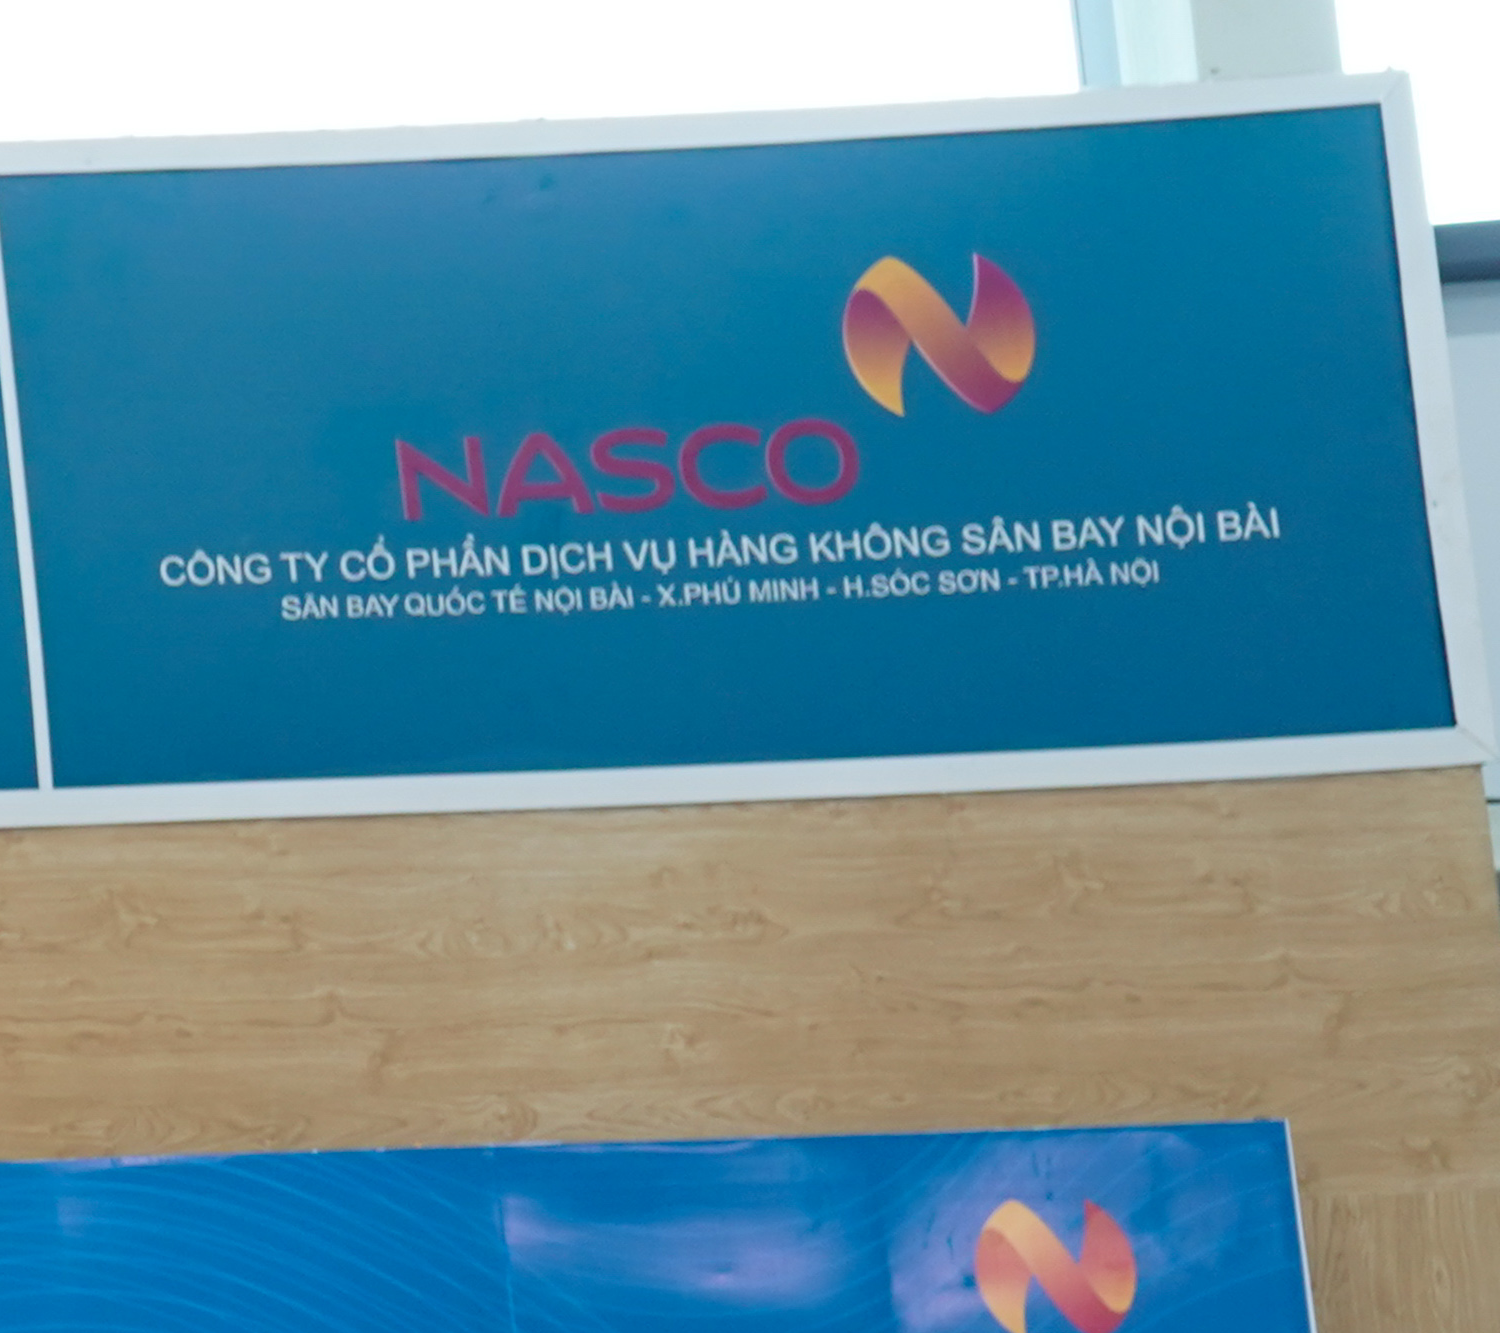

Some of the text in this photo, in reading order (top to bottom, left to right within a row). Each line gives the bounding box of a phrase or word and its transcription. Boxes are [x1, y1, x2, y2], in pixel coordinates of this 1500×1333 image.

[394, 418, 862, 522] NASCO
[159, 501, 1282, 588] CÔNG TY CỔ PHẦN DỊCH VỤ HÀNG KHÔNG SÂN BAY NỘI BÀI
[280, 592, 340, 621] SÂN
[346, 592, 400, 619] BAY
[589, 580, 635, 611] BÀI
[747, 575, 820, 604] MINH
[937, 568, 1002, 596] SƠN
[1109, 556, 1161, 589] NỘI
